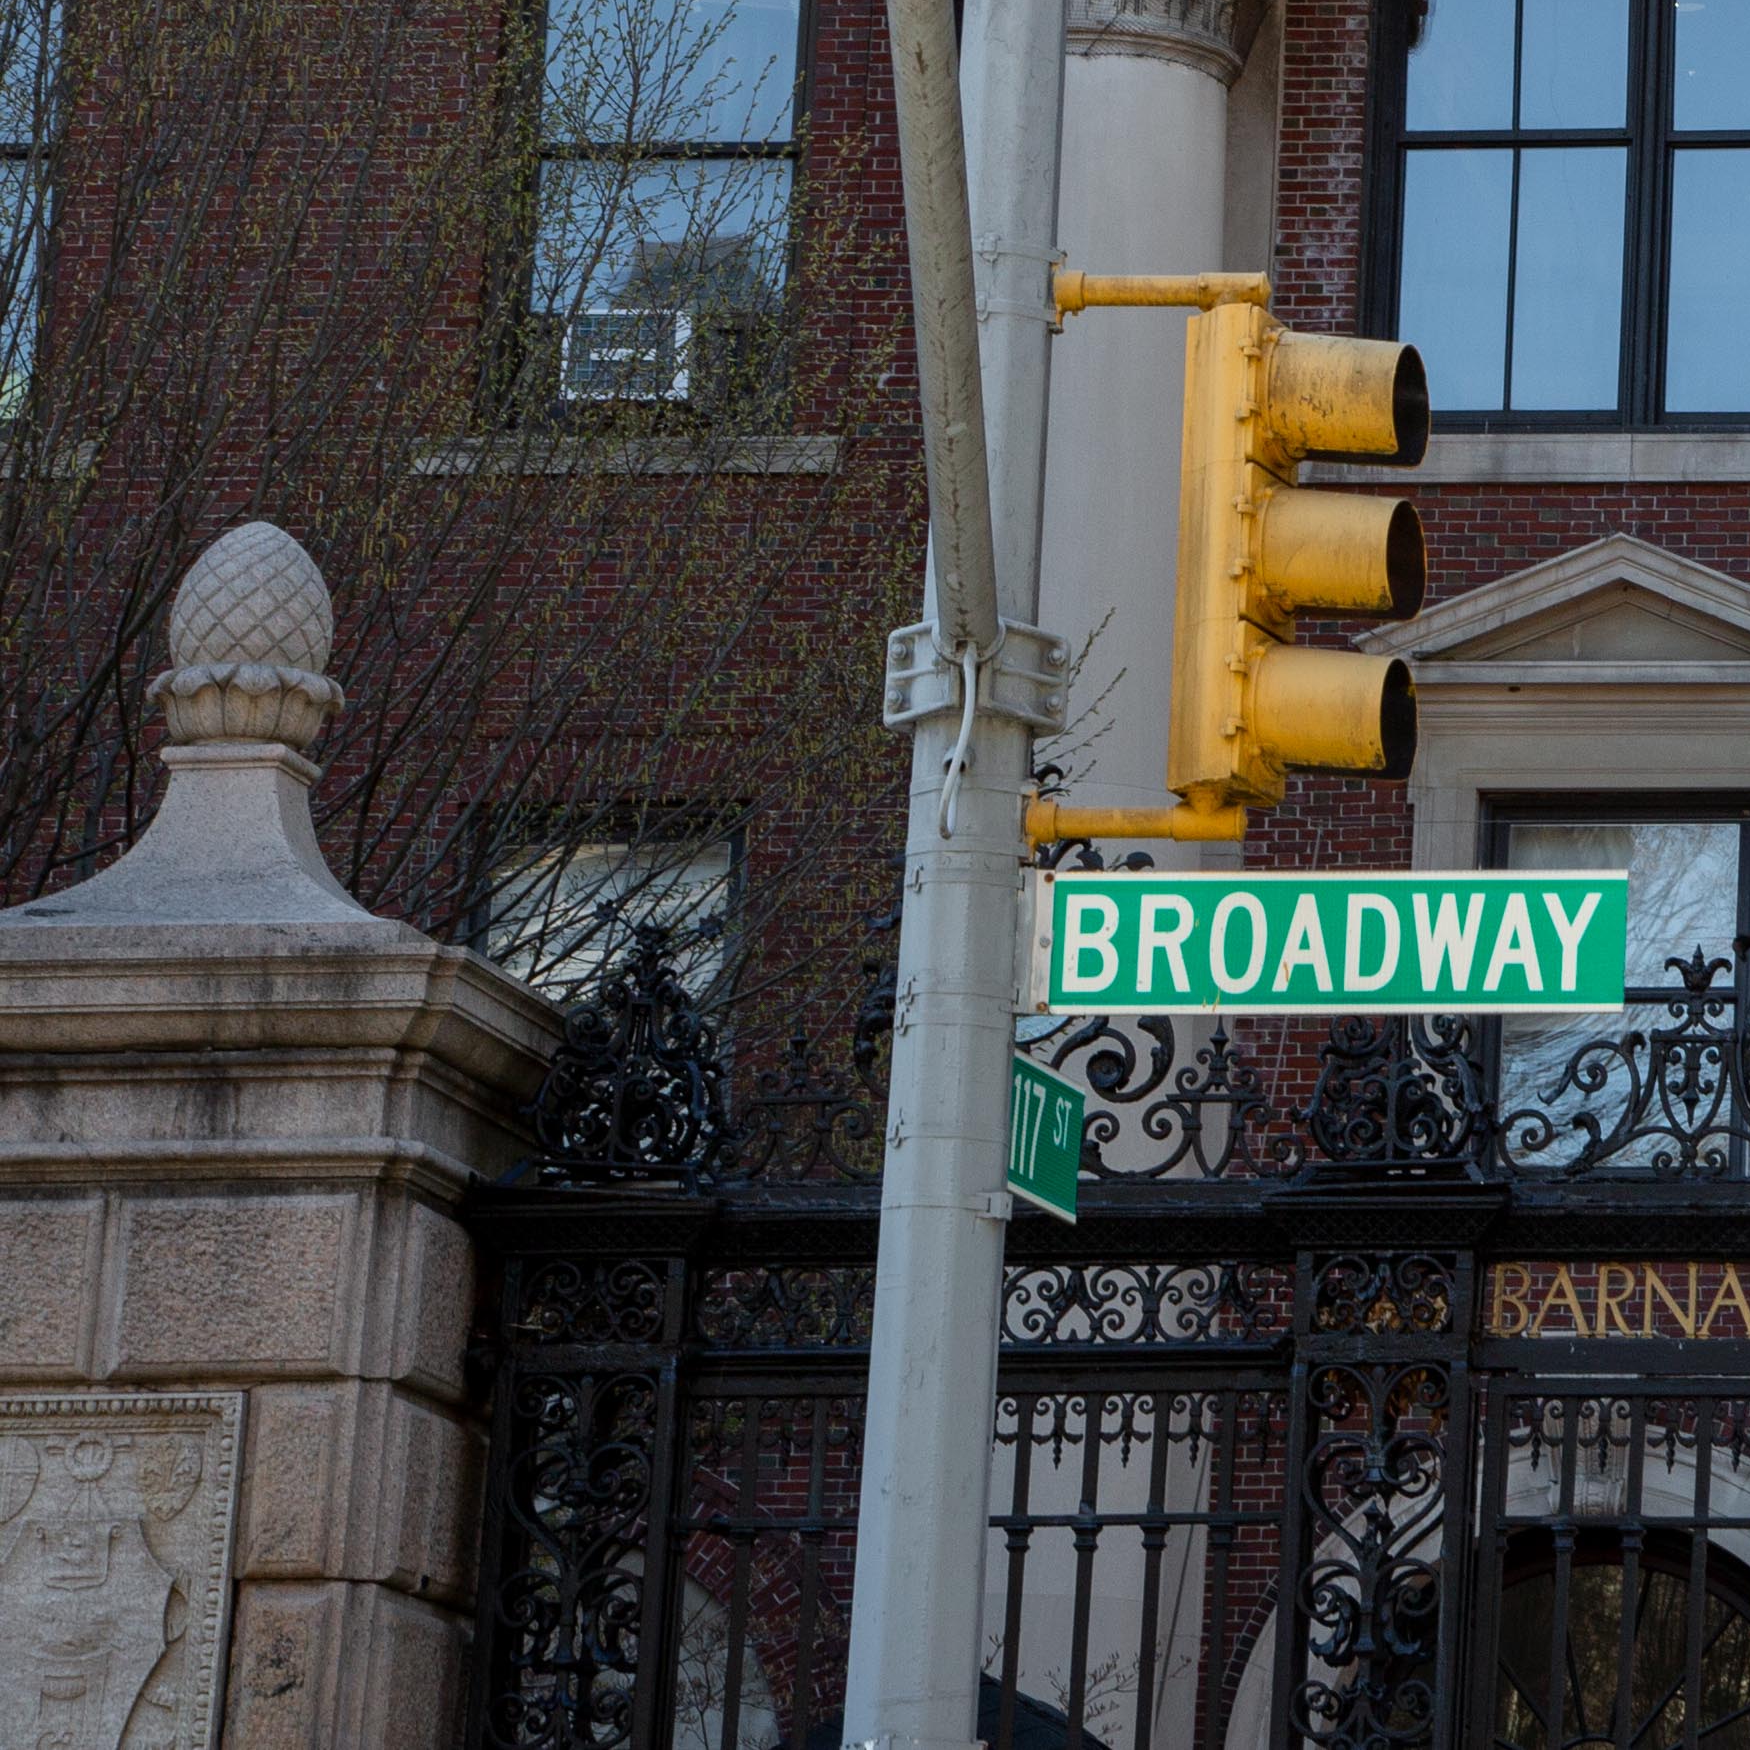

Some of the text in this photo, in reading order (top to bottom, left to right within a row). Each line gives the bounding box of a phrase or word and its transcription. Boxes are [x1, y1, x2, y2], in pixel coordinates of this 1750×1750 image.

[1061, 891, 1602, 994] BROADWAY
[1009, 1073, 1073, 1181] 117 ST
